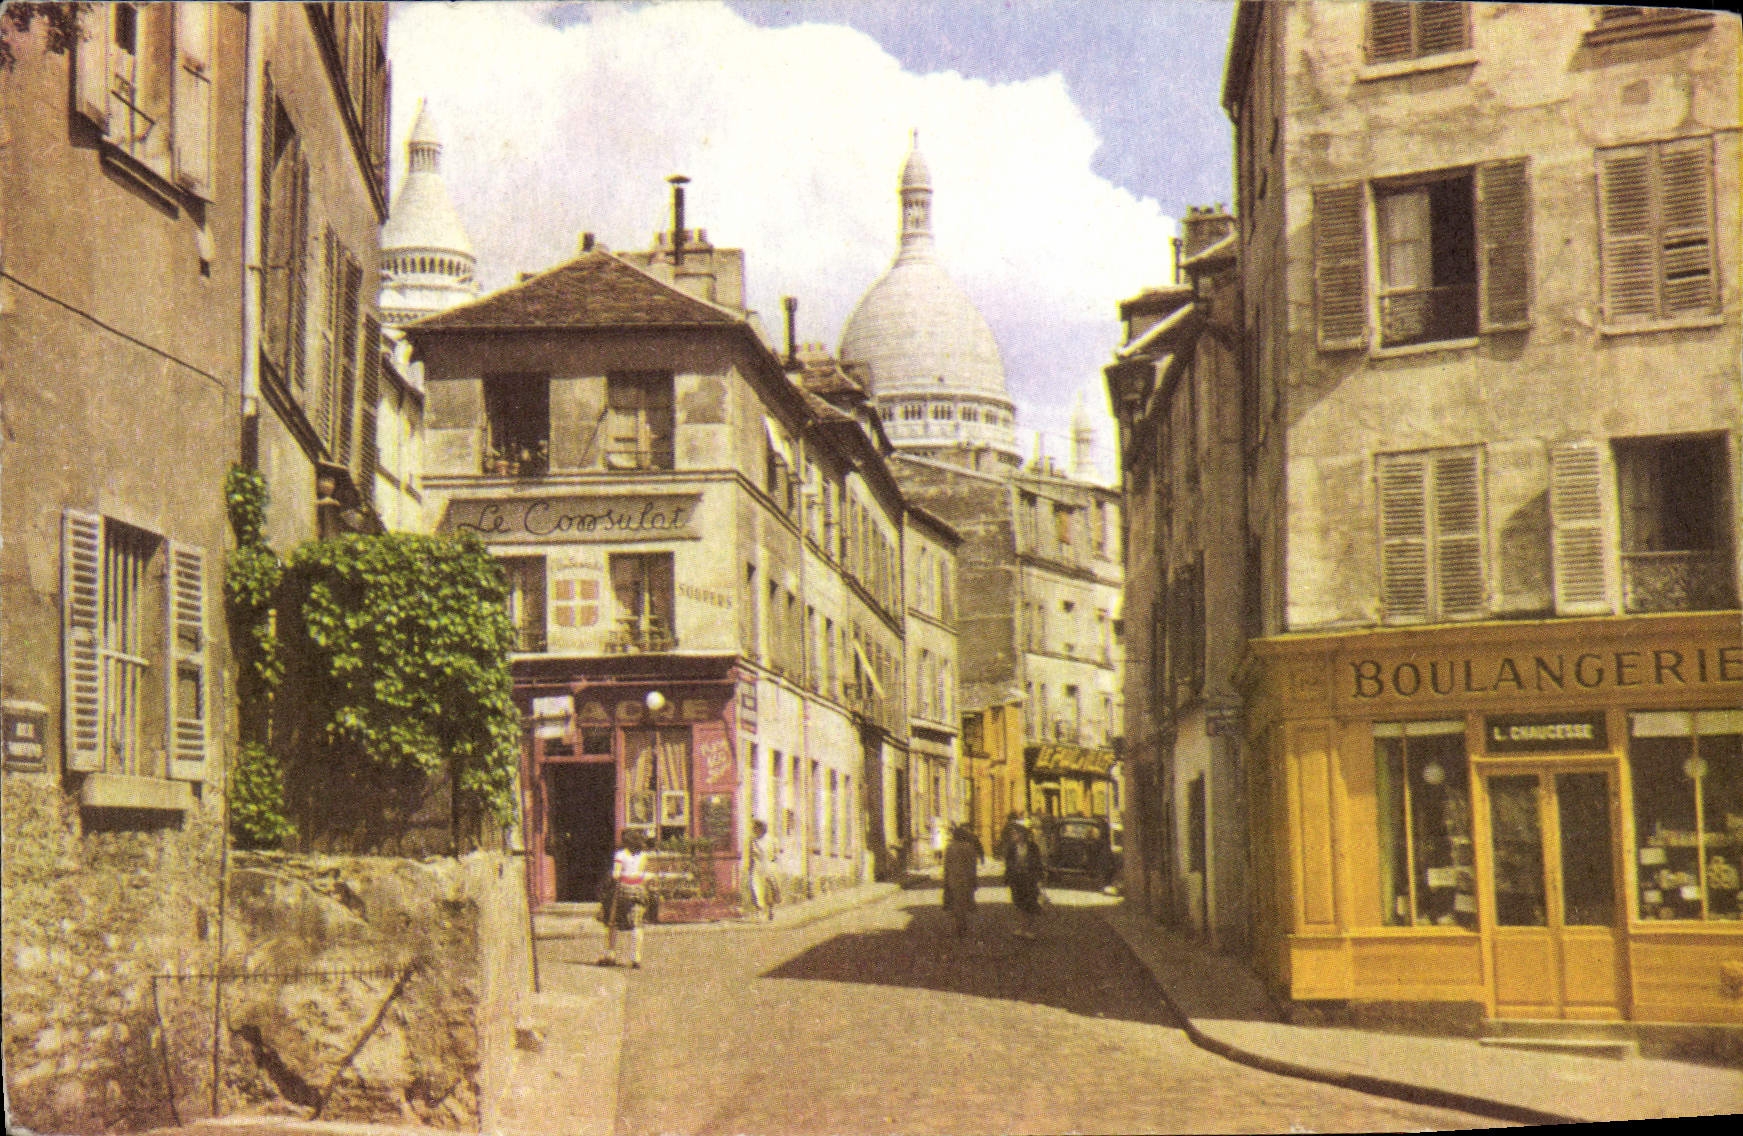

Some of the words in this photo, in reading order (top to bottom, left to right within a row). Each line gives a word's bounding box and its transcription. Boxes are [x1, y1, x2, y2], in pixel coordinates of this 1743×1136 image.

[457, 503, 510, 534] Le
[523, 500, 690, 536] Consulat
[1350, 647, 1743, 699] BOULANGERIE
